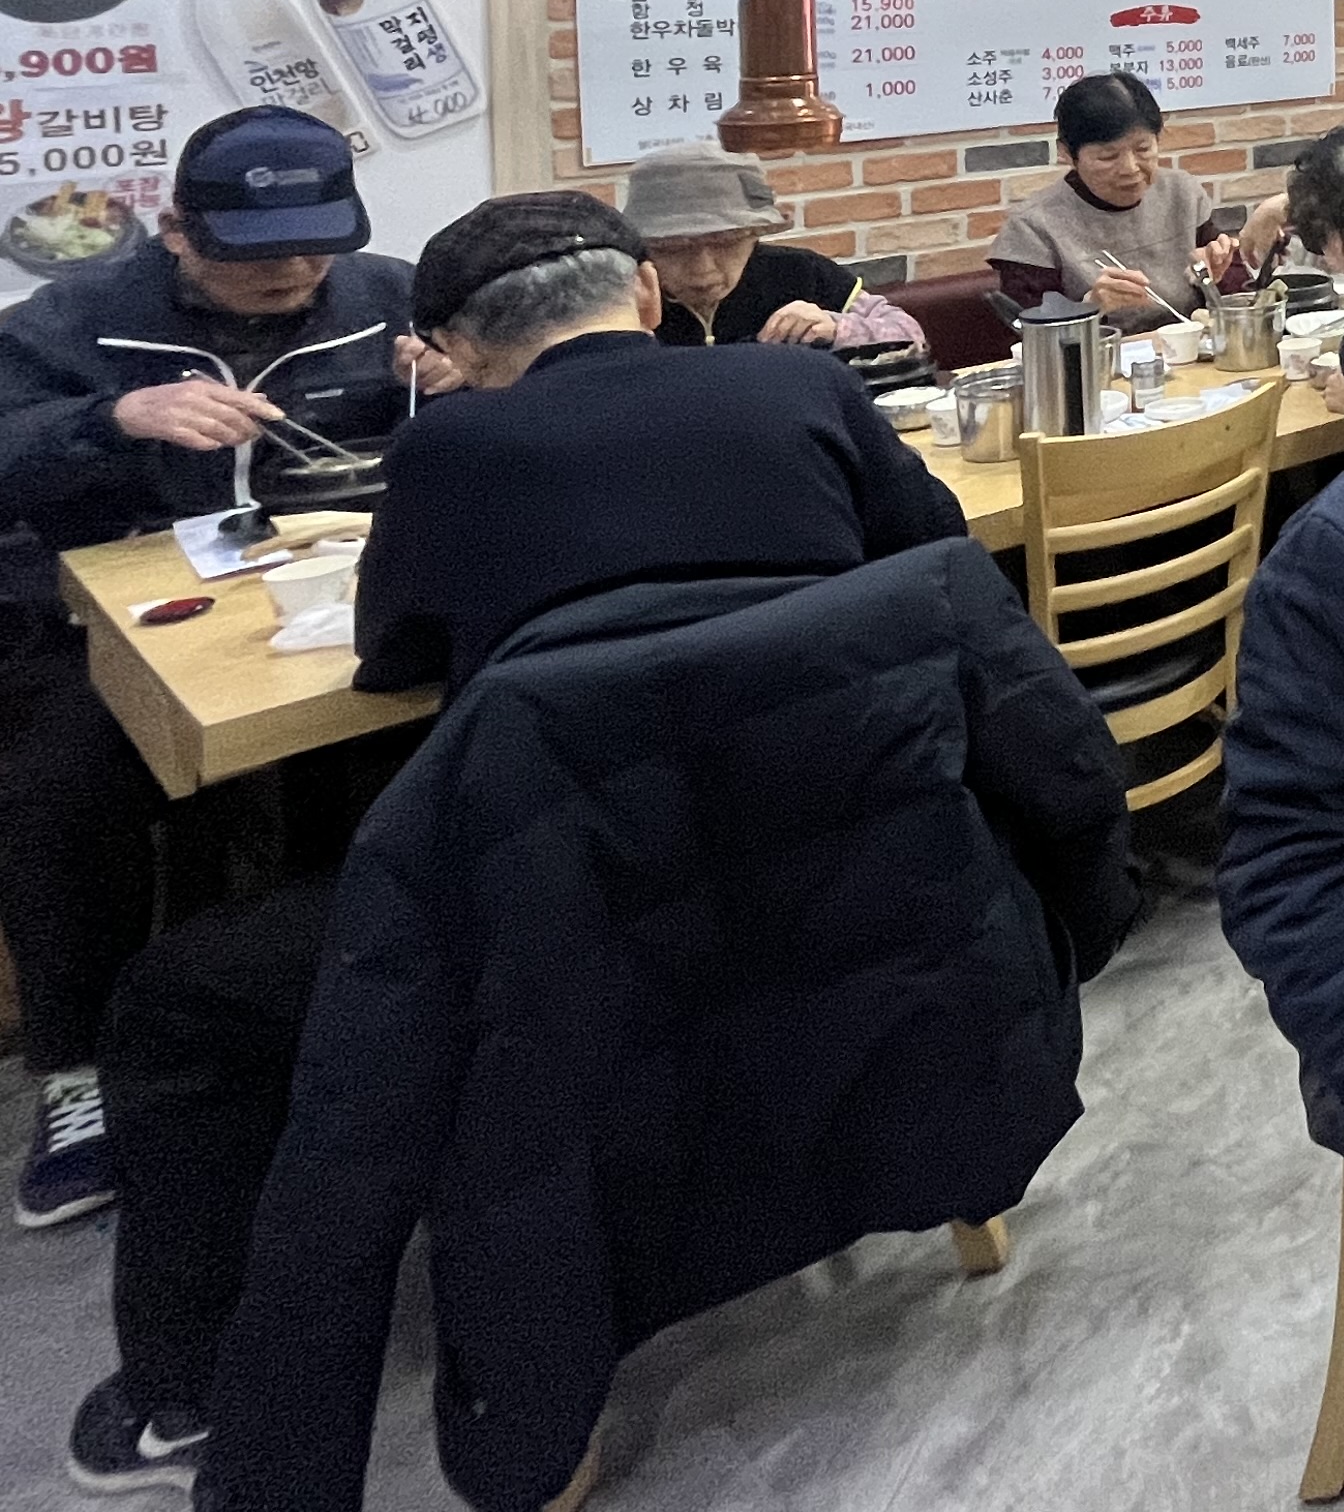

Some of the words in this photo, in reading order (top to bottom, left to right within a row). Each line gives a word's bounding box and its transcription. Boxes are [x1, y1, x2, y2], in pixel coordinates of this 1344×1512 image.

[967, 49, 997, 66] 소주
[1041, 46, 1084, 62] 4,000
[1109, 43, 1136, 58] 맥주
